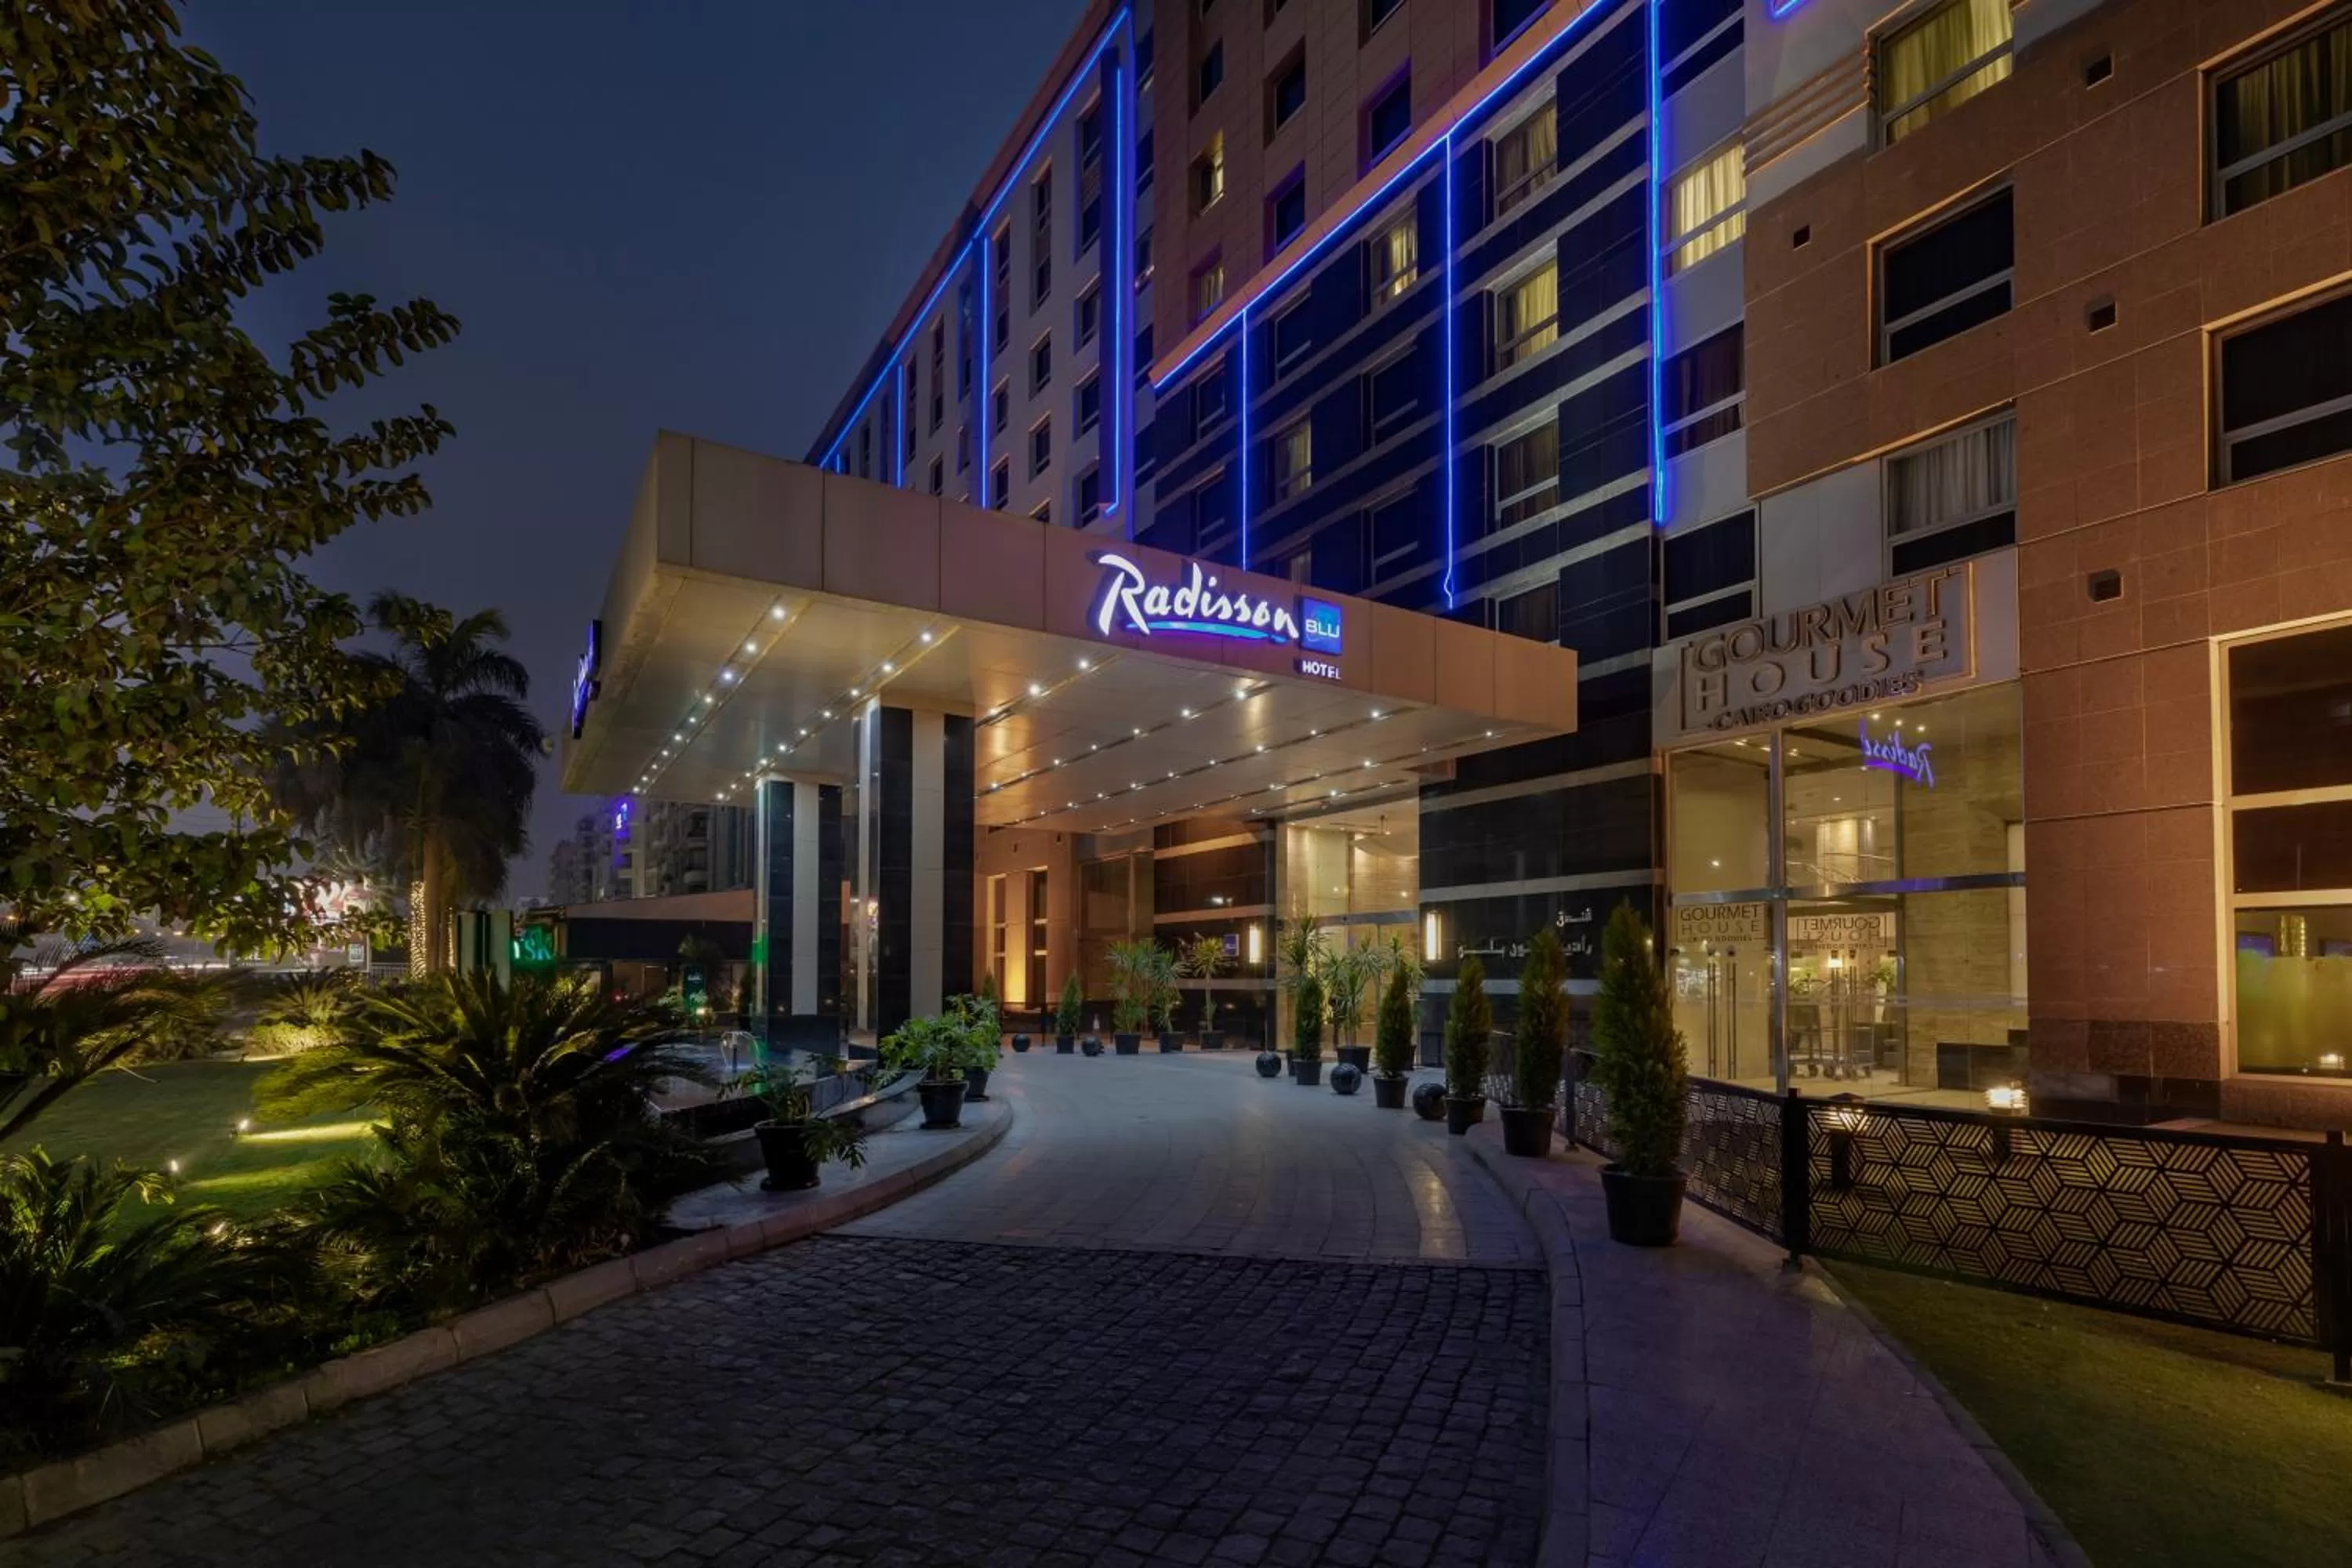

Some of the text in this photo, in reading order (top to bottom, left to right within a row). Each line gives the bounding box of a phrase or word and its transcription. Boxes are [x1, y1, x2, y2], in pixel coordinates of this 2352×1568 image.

[1098, 554, 1298, 639] Radisson
[1305, 619, 1340, 638] BLU
[1691, 566, 1963, 673] GOURMET
[1302, 660, 1341, 680] HOTEL
[1695, 617, 1949, 712] HOUSE
[1680, 904, 1760, 920] GOURMET
[1681, 920, 1762, 935] HOUSE
